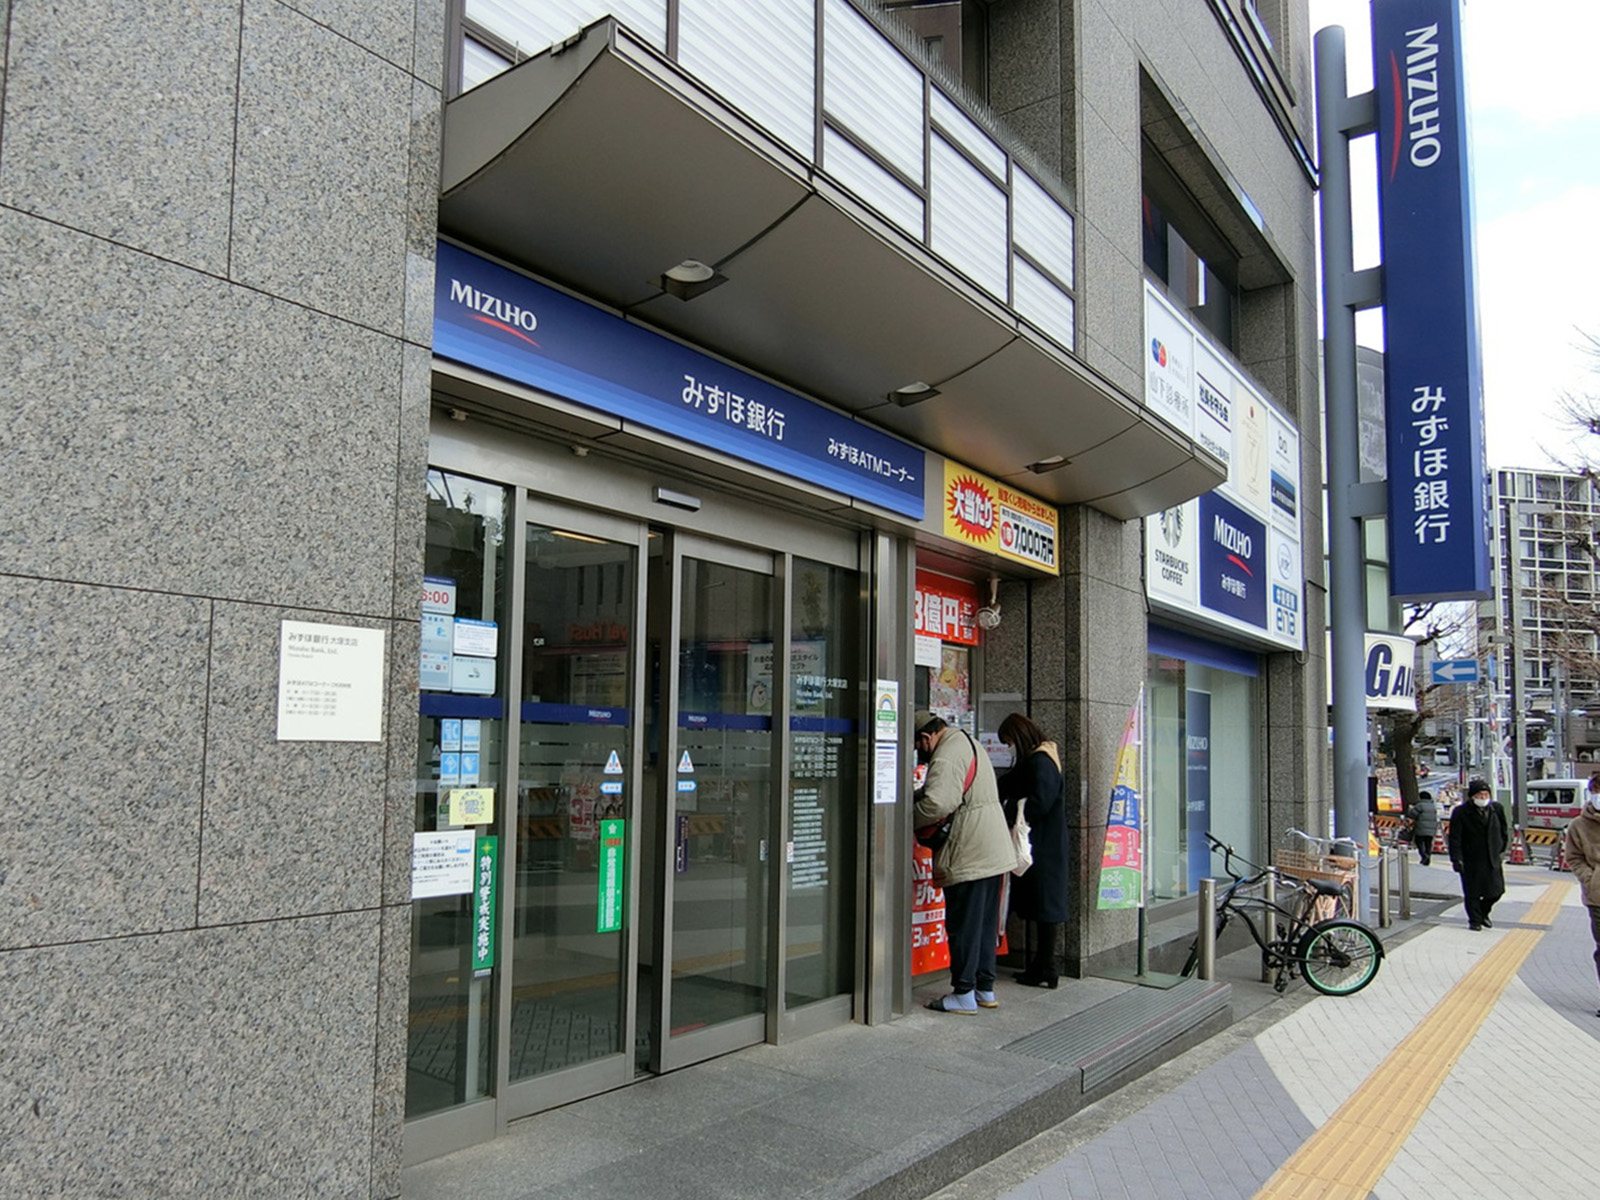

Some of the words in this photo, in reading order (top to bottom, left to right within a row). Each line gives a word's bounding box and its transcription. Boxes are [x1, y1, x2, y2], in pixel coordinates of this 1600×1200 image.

[1405, 21, 1442, 168] MIZUHO
[449, 279, 538, 333] MIZUHO
[681, 373, 786, 442] みずほ銀行
[826, 436, 916, 484] みずほATMコーナー
[1410, 385, 1451, 545] みずほ銀行
[952, 482, 994, 532] 大当たり
[1213, 513, 1253, 560] MIZUHO
[1154, 548, 1189, 575] STARBUCKS
[1161, 566, 1184, 587] COFFEE
[1221, 573, 1247, 600] みずほ銀行
